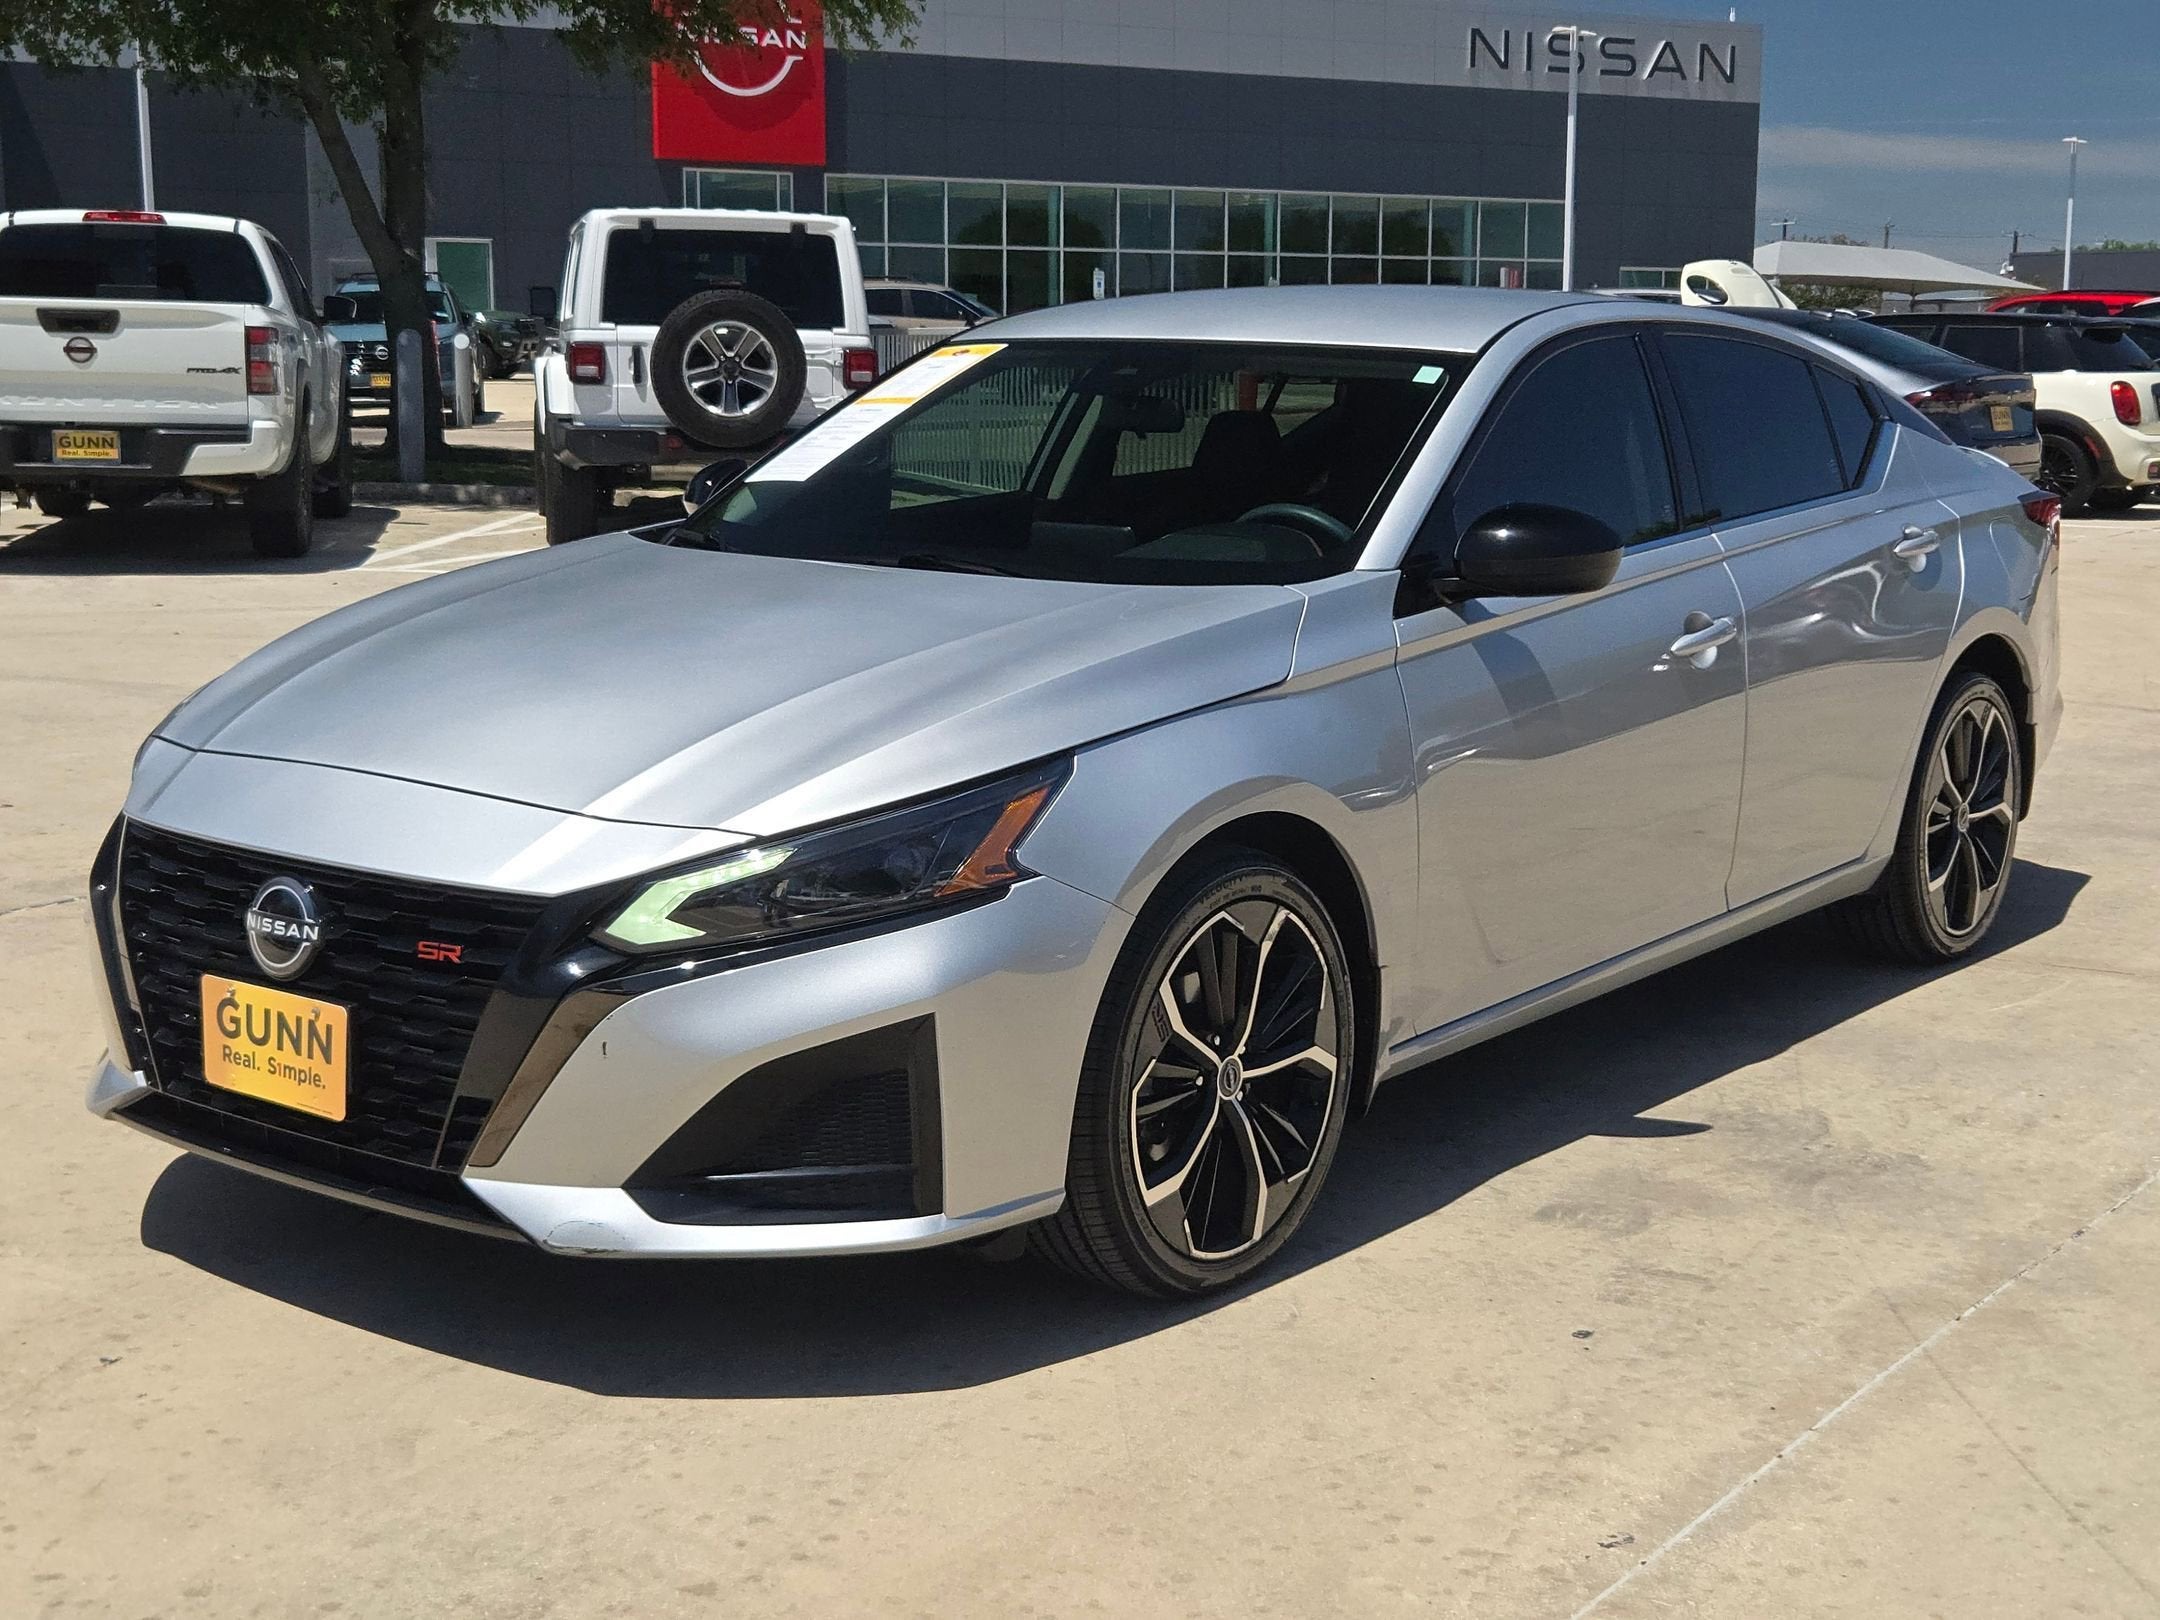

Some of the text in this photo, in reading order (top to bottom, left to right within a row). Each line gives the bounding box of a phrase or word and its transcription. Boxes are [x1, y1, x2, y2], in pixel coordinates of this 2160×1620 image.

[1469, 27, 1736, 84] NISSAN
[59, 436, 115, 448] GUNN
[246, 911, 320, 941] NISSAN
[417, 940, 464, 964] SR
[216, 997, 333, 1065] GUNN
[222, 1044, 261, 1071] Real.
